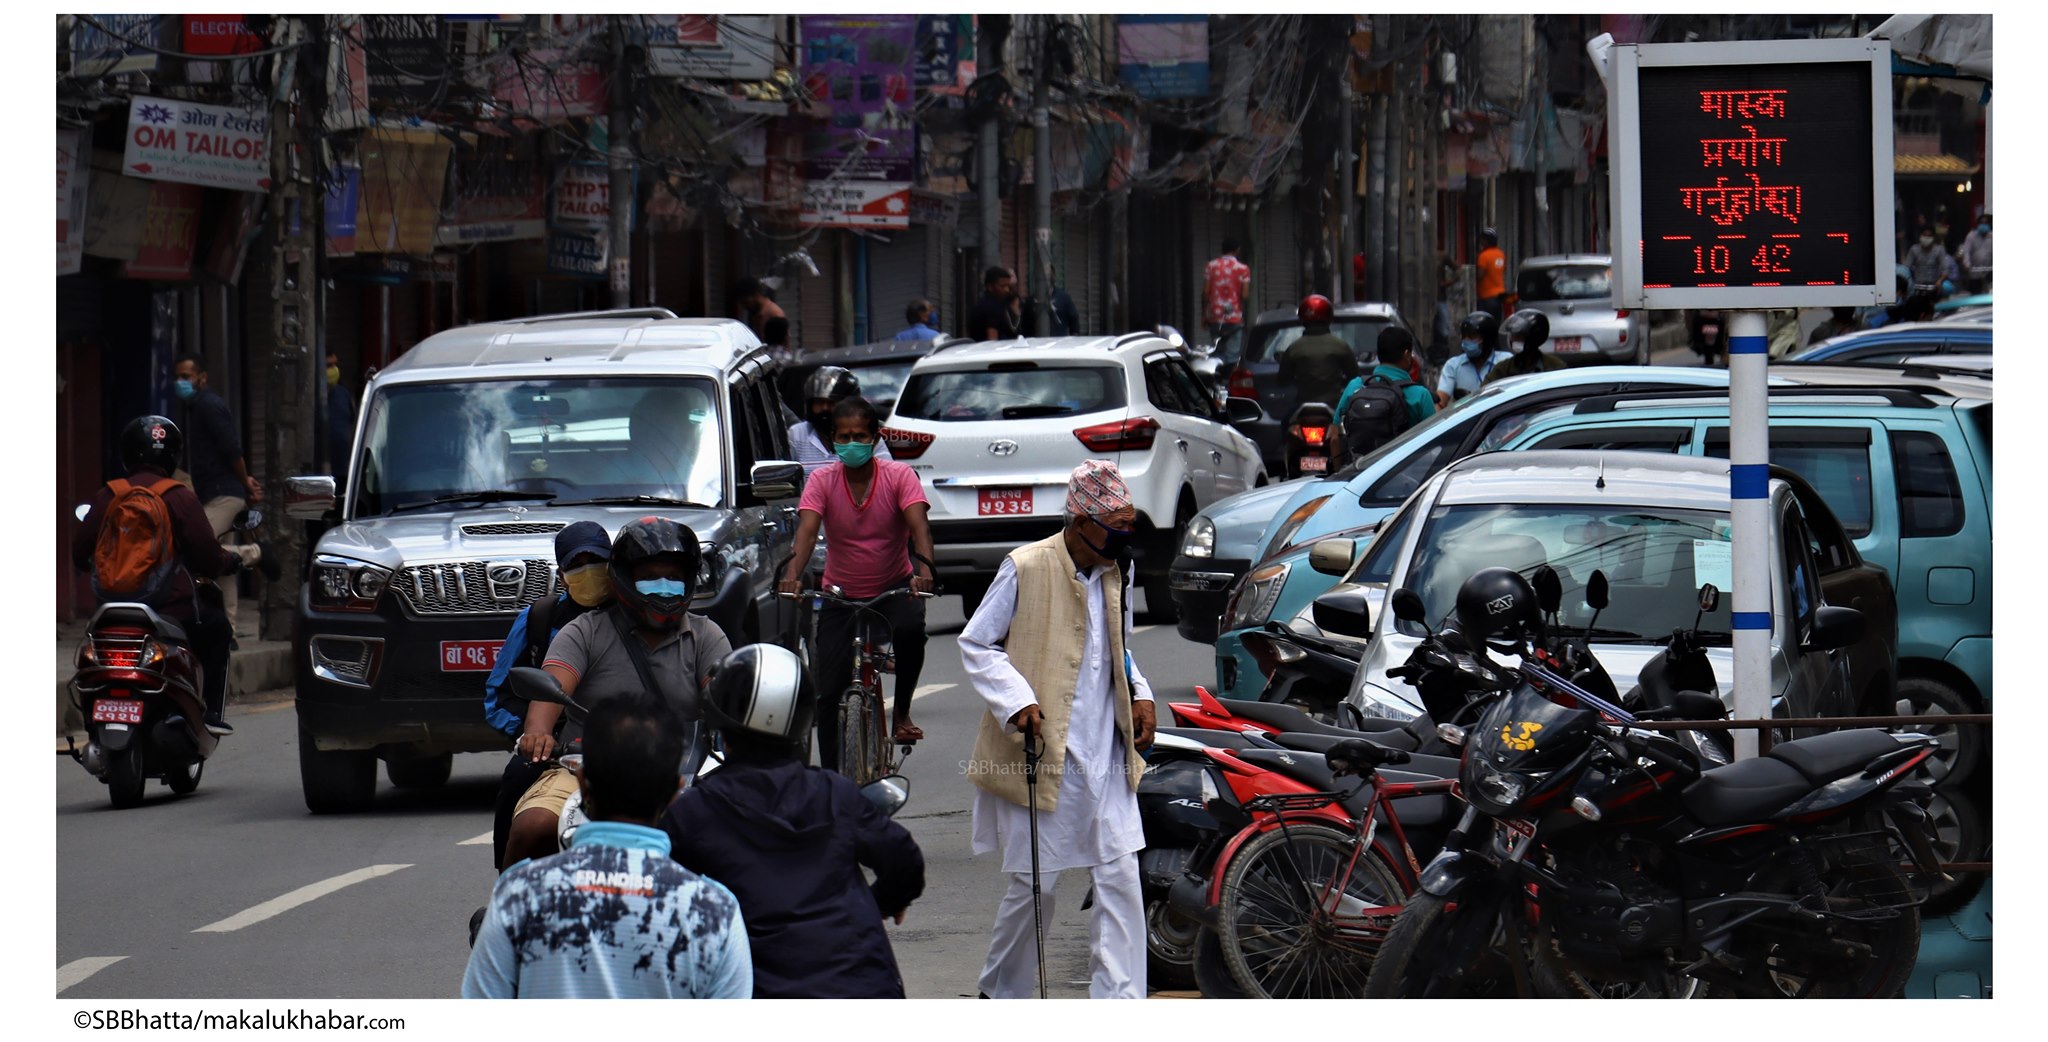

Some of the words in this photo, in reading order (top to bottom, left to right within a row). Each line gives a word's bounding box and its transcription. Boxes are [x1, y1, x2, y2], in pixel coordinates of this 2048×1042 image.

[181, 107, 217, 128] ओम
[1699, 89, 1789, 120] मास्क
[134, 125, 177, 151] OM
[185, 131, 268, 161] TAILOR
[1699, 124, 1789, 168] प्रयोग
[556, 200, 612, 216] TAILOR
[1692, 244, 1731, 274] 10
[1751, 243, 1792, 274] 42
[466, 646, 487, 666] १६
